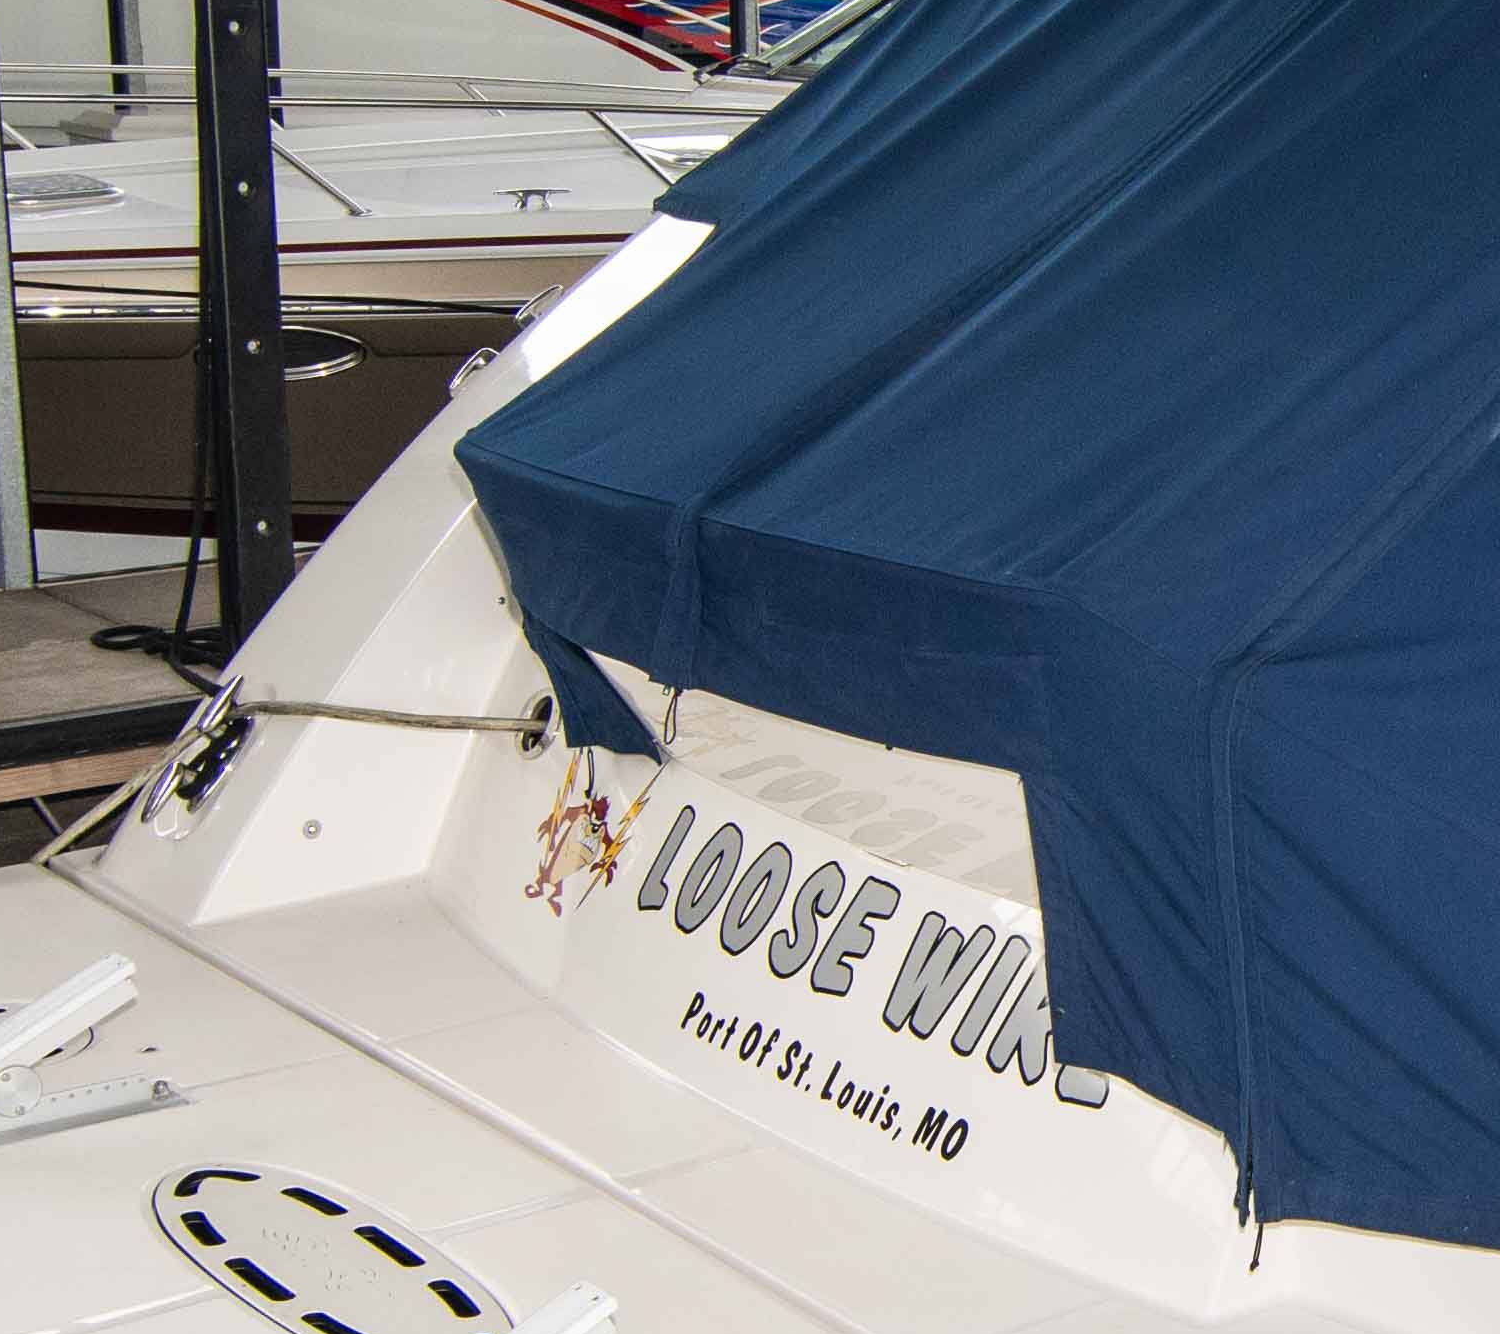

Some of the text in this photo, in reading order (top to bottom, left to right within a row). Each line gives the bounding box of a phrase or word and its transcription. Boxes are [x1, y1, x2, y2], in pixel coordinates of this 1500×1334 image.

[637, 804, 1110, 1110] LOOSE WIR
[680, 991, 969, 1161] Port Of St. Louis, MO
